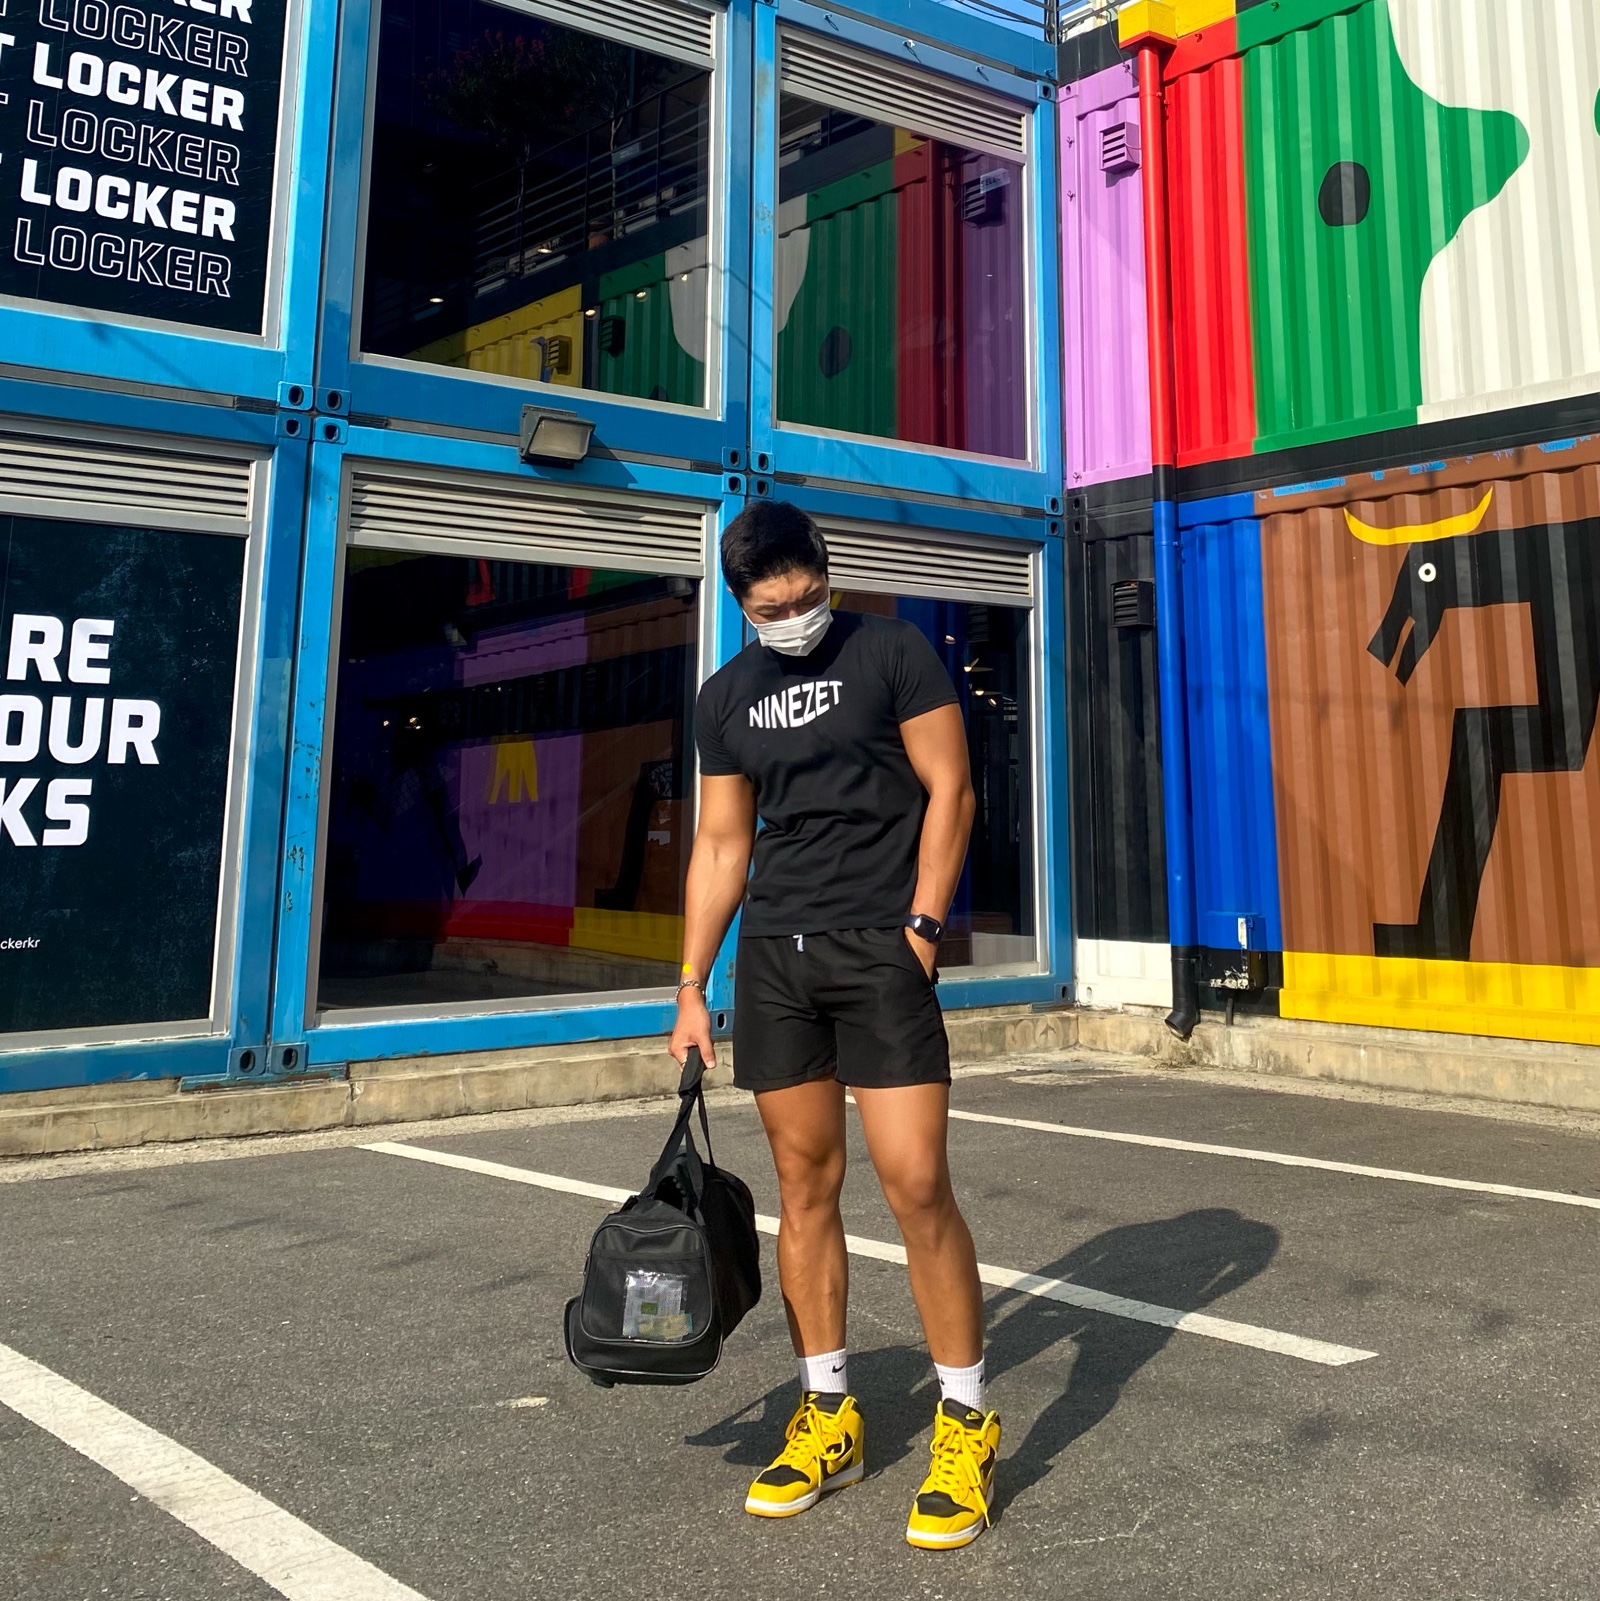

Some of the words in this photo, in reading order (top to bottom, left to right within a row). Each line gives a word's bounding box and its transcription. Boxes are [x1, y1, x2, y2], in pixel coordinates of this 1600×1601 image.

[39, 0, 248, 77] LOCKER
[33, 42, 244, 131] LOCKER
[27, 100, 239, 185] LOCKER
[21, 158, 235, 241] LOCKER
[14, 218, 231, 297] LOCKER
[7, 614, 114, 684] RE
[0, 694, 160, 764] OUR
[748, 680, 843, 729] NINEZET
